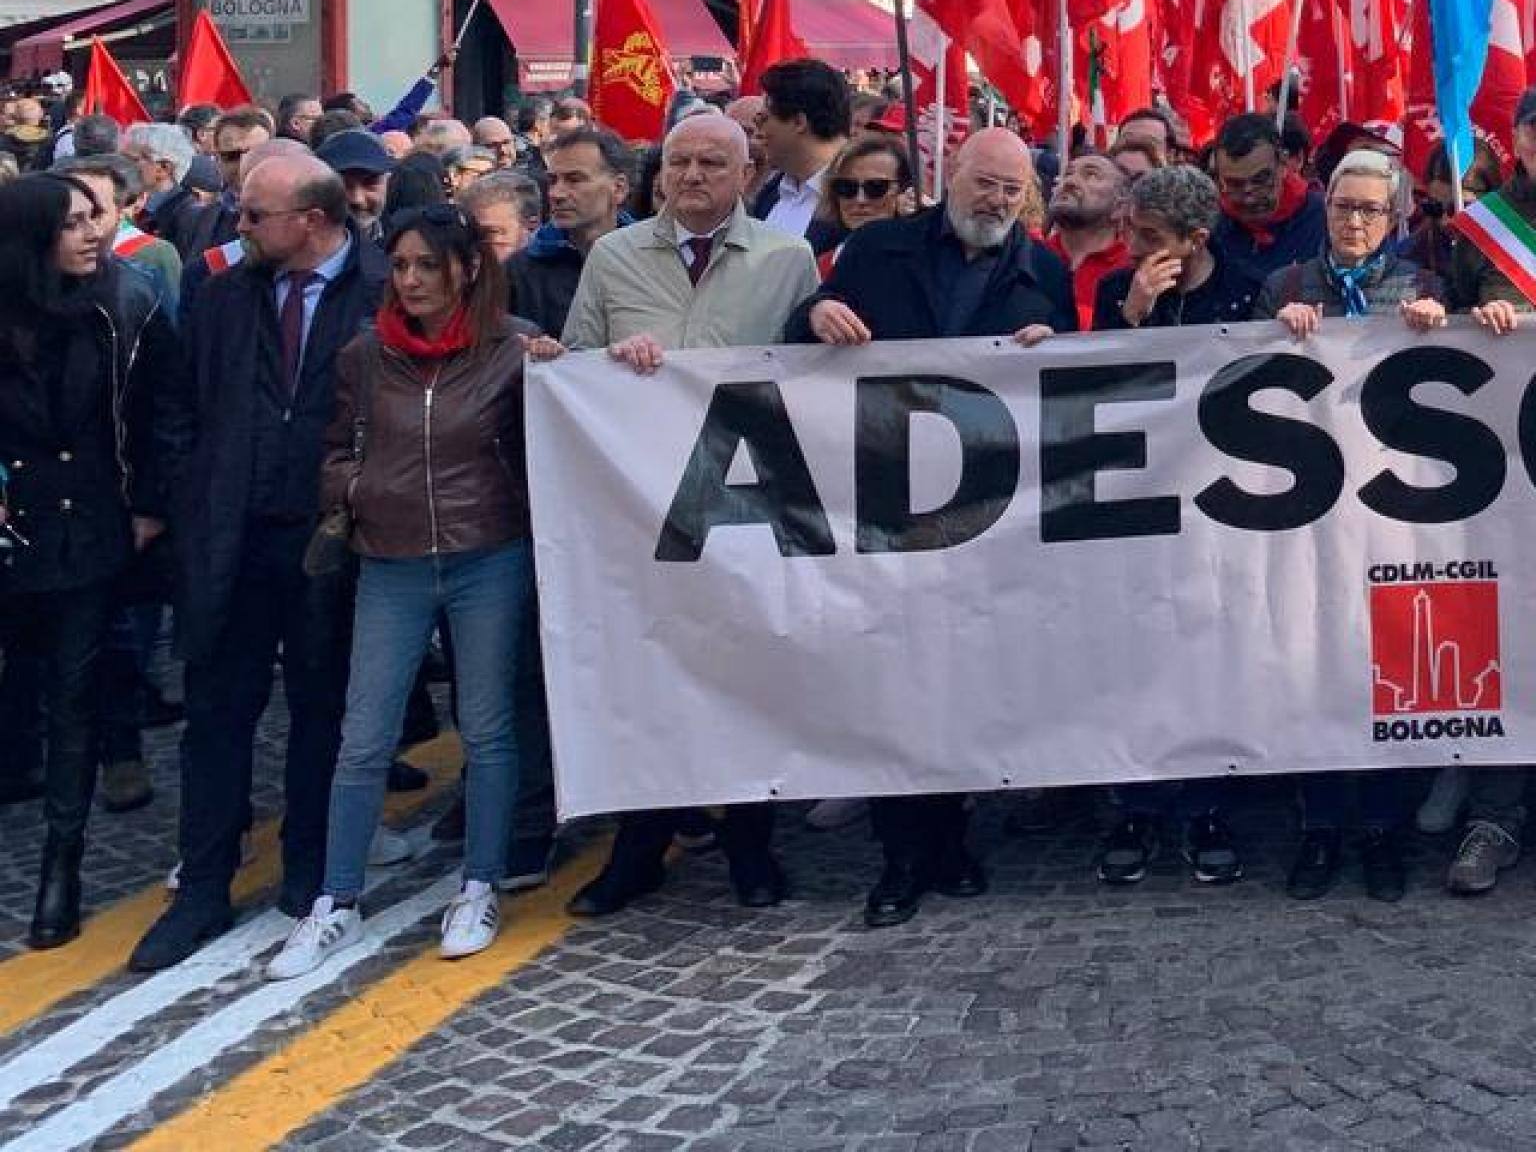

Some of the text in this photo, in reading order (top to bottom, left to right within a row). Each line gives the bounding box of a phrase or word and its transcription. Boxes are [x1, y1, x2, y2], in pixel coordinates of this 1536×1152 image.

[210, 0, 304, 16] BOLOGNA
[1368, 561, 1498, 582] CDLM-CGIL
[1372, 717, 1506, 742] BOLOGNA
